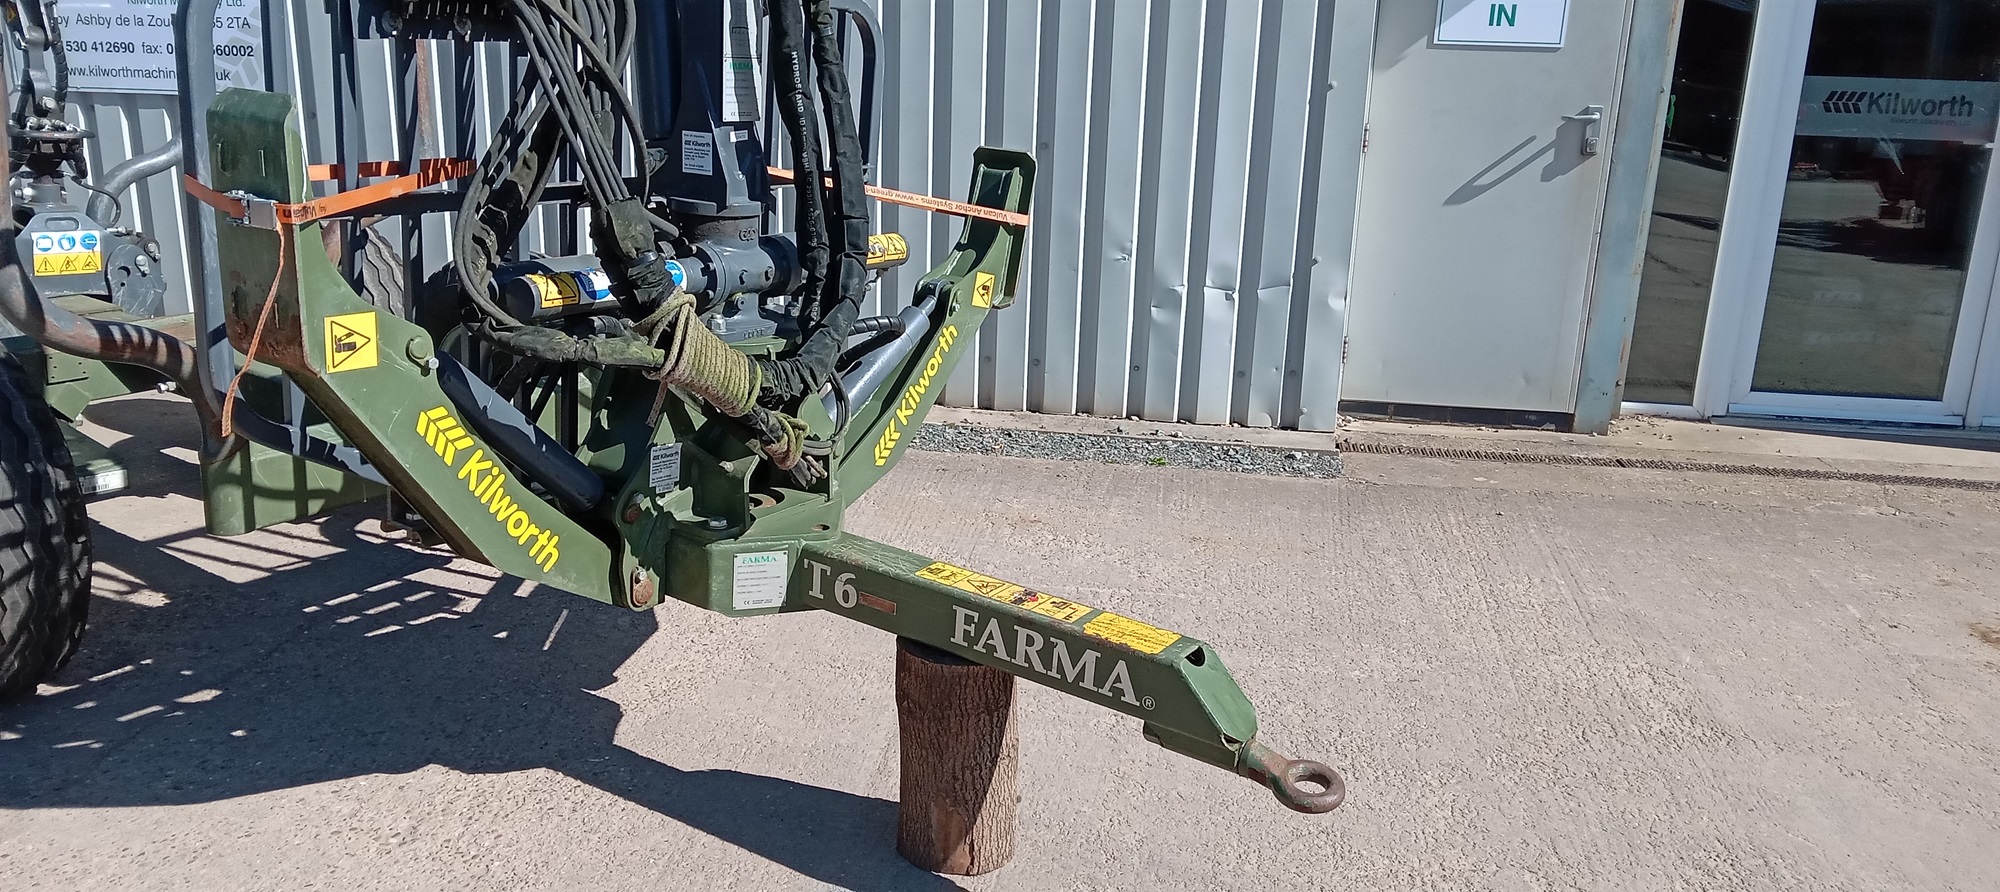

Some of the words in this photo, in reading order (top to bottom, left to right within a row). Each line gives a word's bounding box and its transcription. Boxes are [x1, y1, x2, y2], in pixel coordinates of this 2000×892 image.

[76, 13, 112, 29] Ashby
[115, 14, 131, 27] de
[134, 15, 144, 27] la
[147, 15, 171, 27] Zou
[226, 17, 251, 29] 2TA
[1488, 3, 1518, 27] IN
[65, 40, 87, 52] 530
[91, 41, 135, 54] 412690
[141, 42, 163, 54] fax:
[1866, 91, 1974, 117] Kilworth
[921, 197, 953, 211] Systems
[954, 204, 983, 215] Anchor
[983, 209, 1008, 221] Vulcan
[896, 324, 959, 426] Kilworth
[457, 448, 560, 573] Kilworth
[742, 555, 777, 564] FARMA
[803, 558, 858, 608] T6
[950, 605, 1140, 707] FARMA
